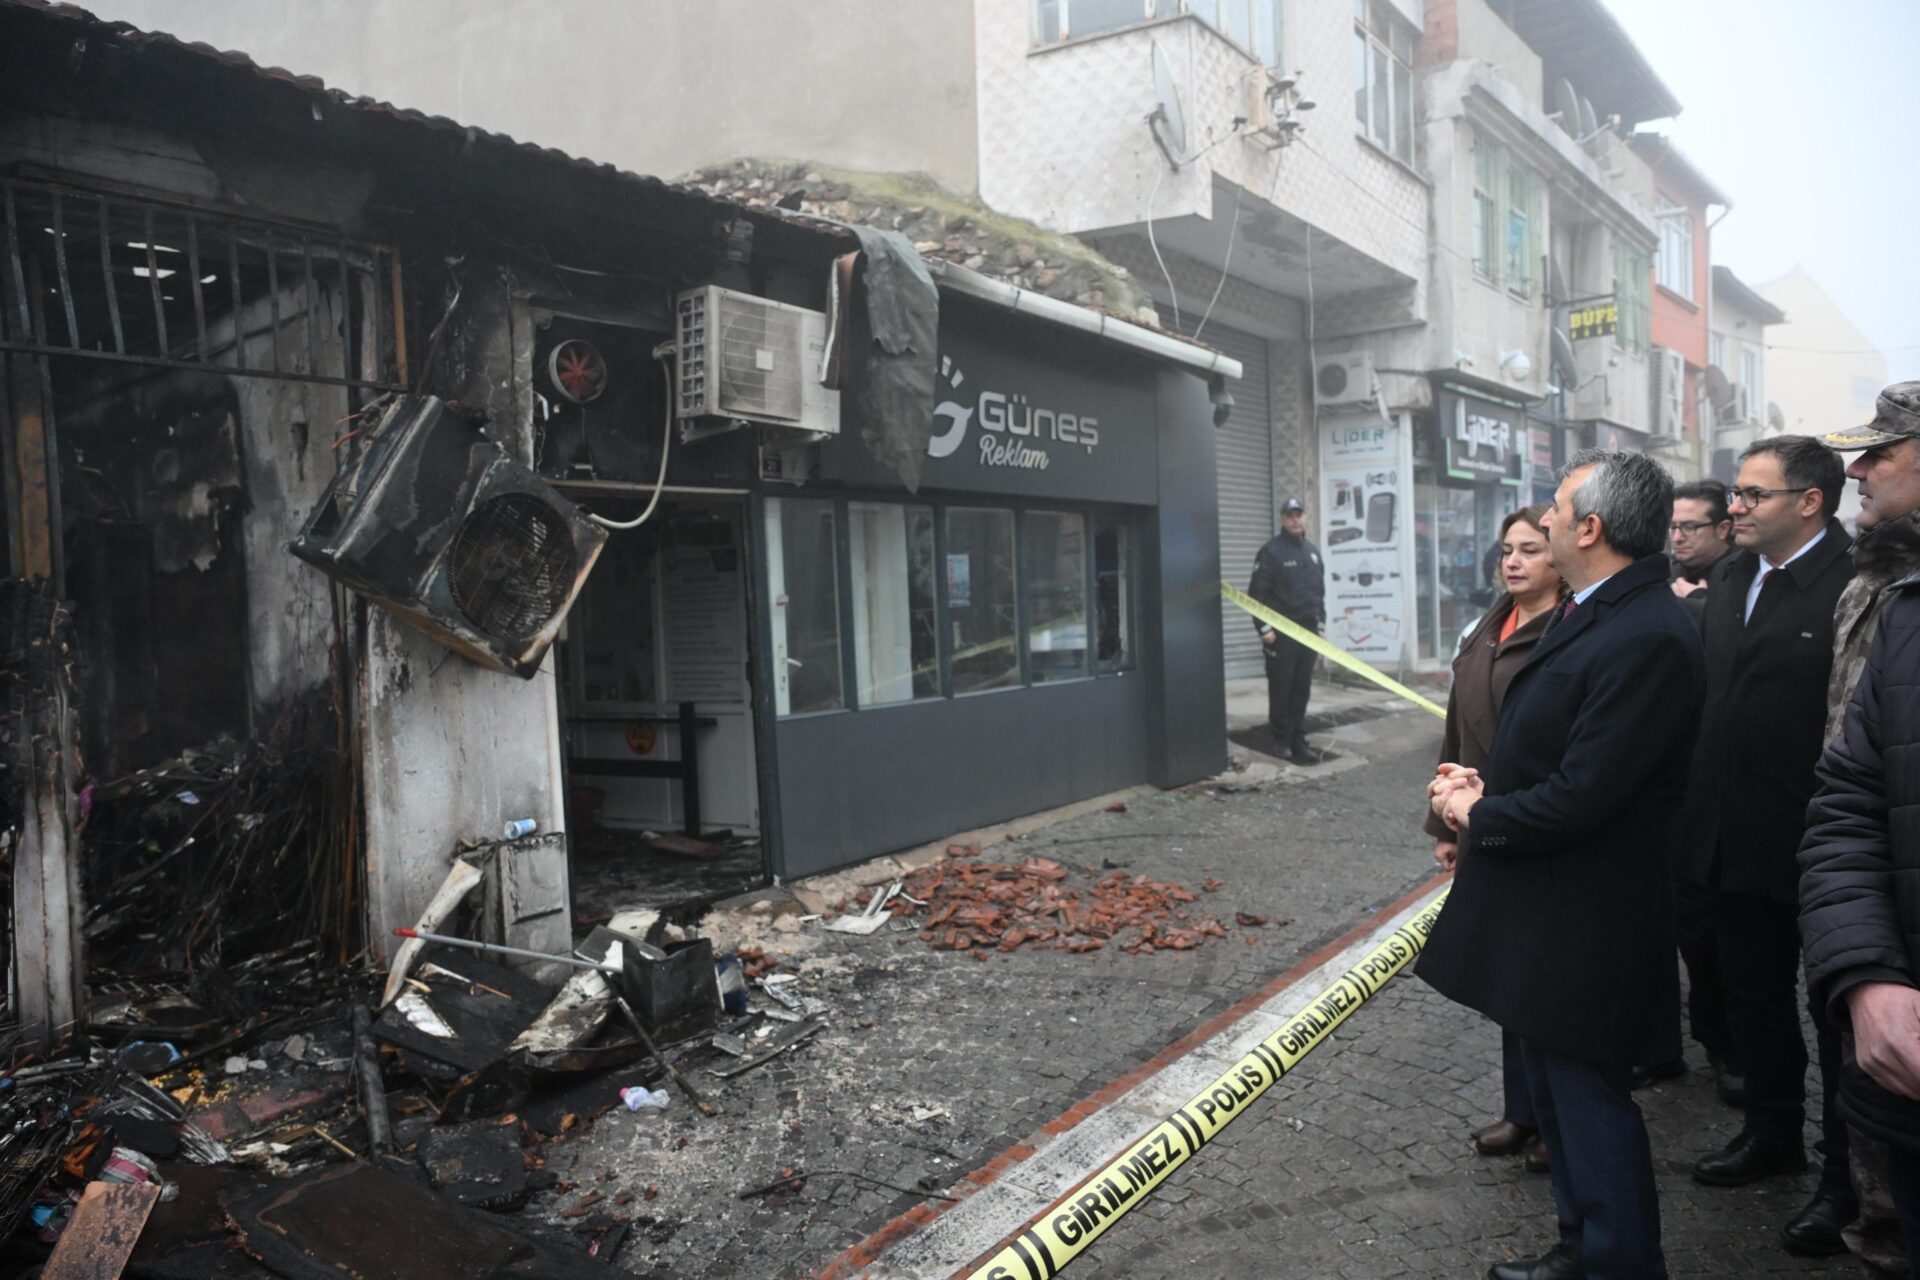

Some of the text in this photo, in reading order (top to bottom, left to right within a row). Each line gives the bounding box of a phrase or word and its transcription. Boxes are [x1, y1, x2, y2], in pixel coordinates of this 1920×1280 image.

[1570, 305, 1618, 329] BÜFE
[978, 390, 1099, 455] Güneş
[979, 434, 1050, 471] Reklam
[1052, 1132, 1182, 1246] GİRİLMEZ
[1195, 1064, 1264, 1127] POLİS
[1276, 985, 1357, 1056] GİRİLMEZ
[1361, 942, 1407, 983] POLİS
